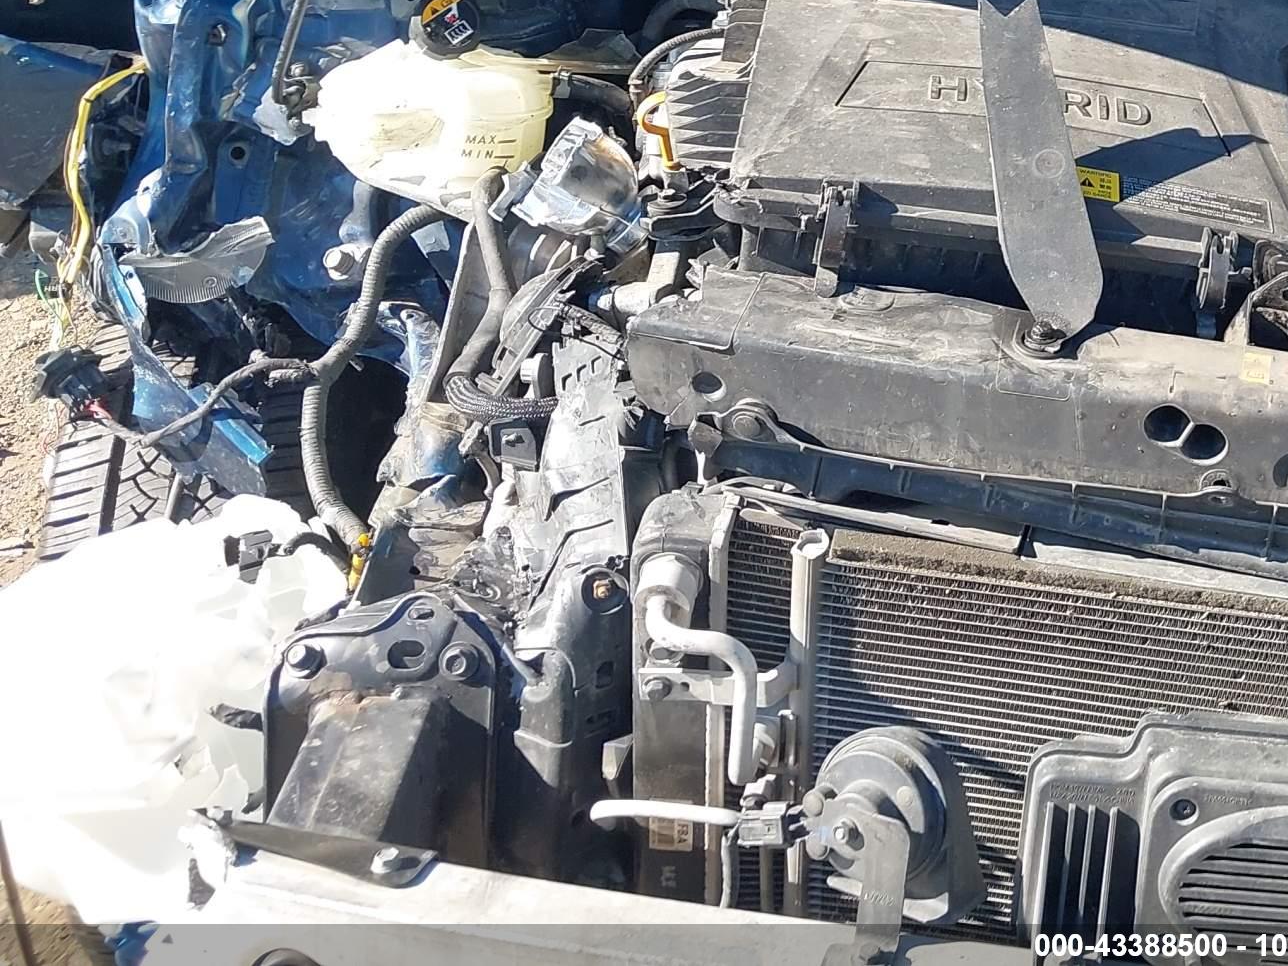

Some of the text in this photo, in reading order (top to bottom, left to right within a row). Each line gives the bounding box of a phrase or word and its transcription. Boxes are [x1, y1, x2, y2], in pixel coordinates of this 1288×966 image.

[929, 74, 1152, 126] HRID
[465, 134, 497, 145] MAX
[461, 148, 494, 159] MIN
